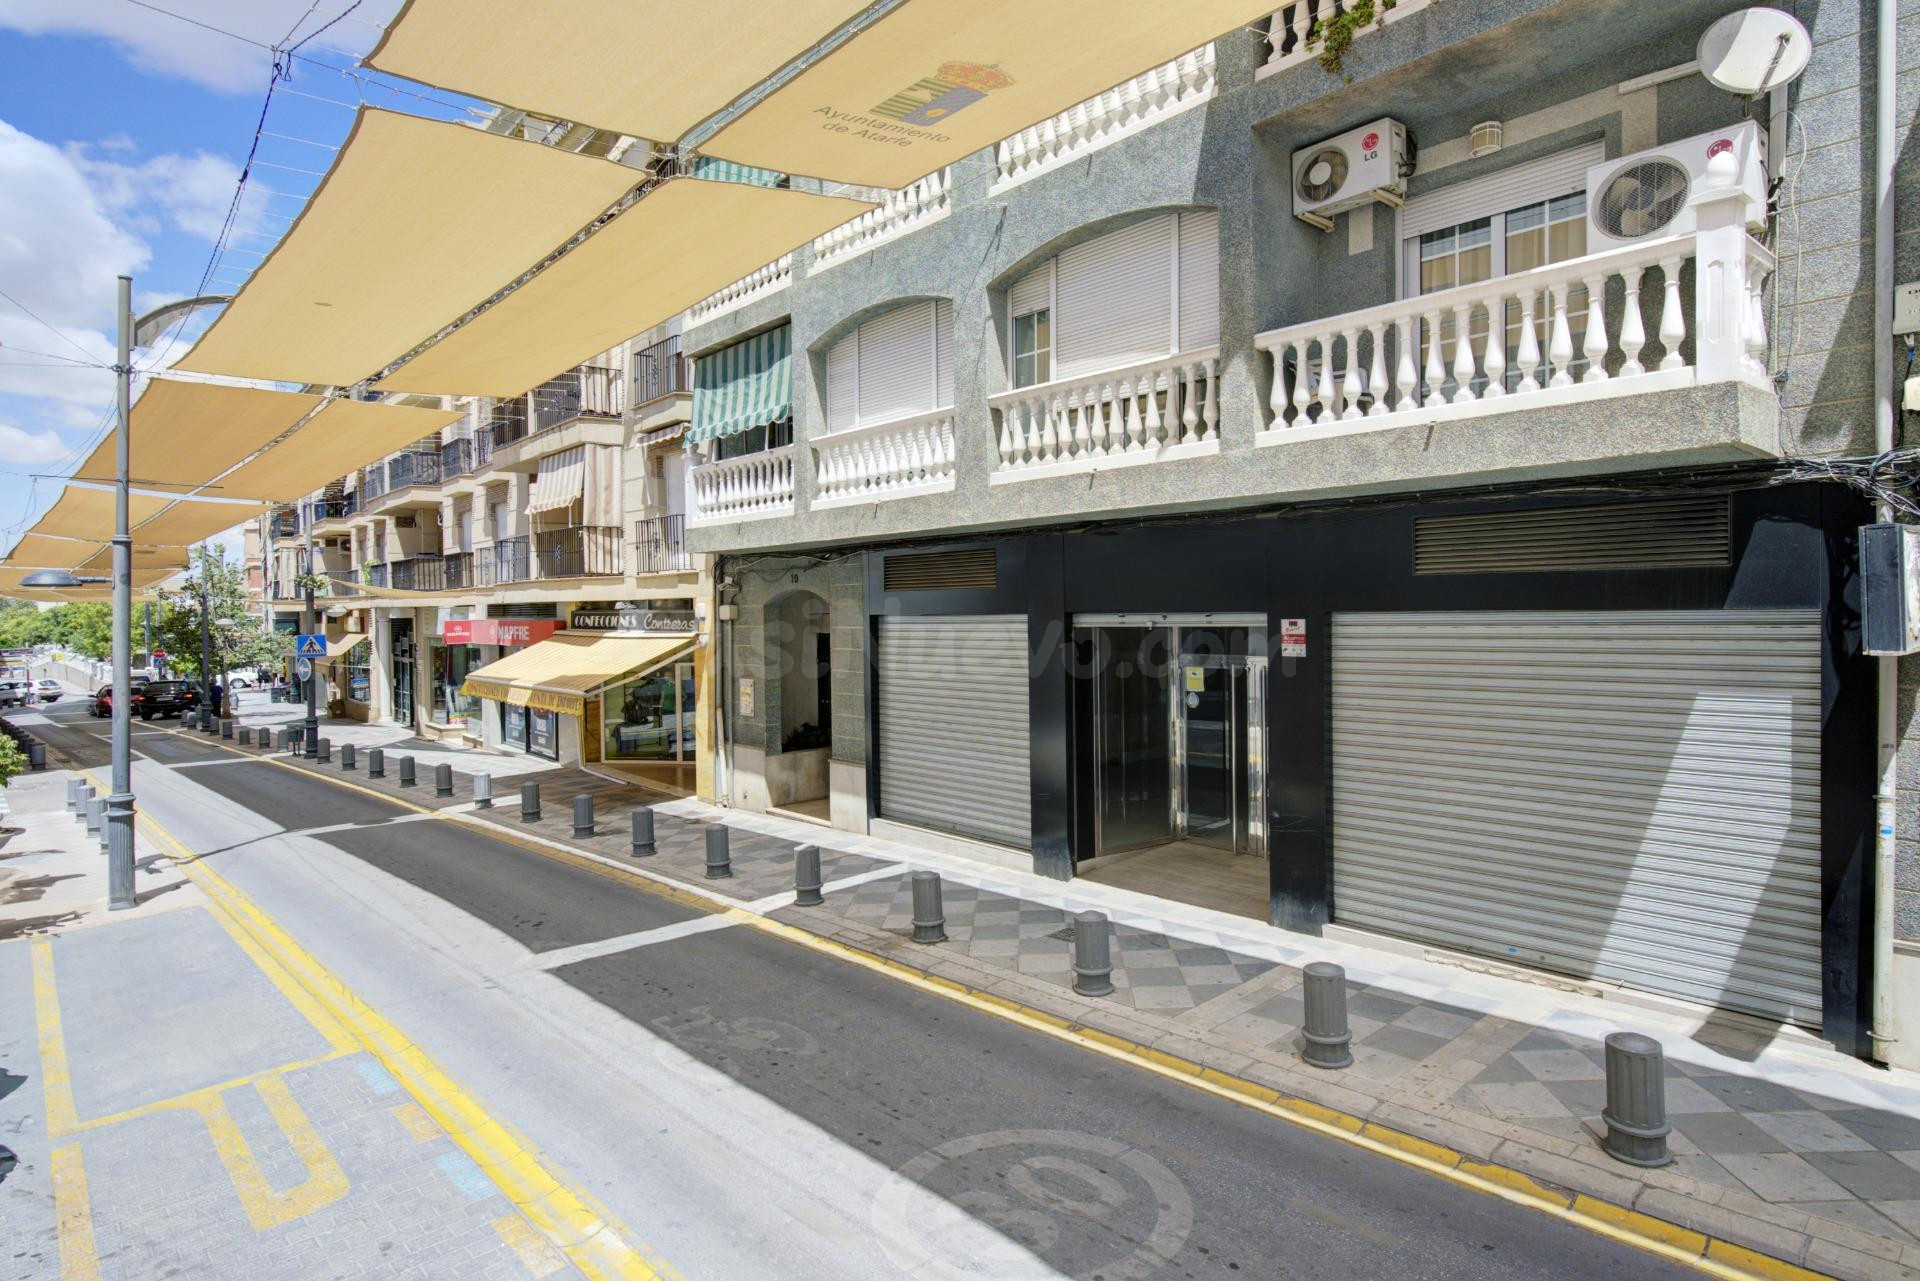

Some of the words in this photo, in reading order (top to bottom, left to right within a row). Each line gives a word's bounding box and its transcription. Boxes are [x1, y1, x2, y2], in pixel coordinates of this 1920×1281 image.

[812, 105, 951, 143] Ayuntamiento
[821, 122, 849, 133] de
[851, 129, 913, 147] Atarfe
[1364, 151, 1378, 162] LG
[574, 615, 637, 628] CONFECCIONES
[643, 613, 696, 632] Contreras
[497, 625, 530, 641] MAPFRE
